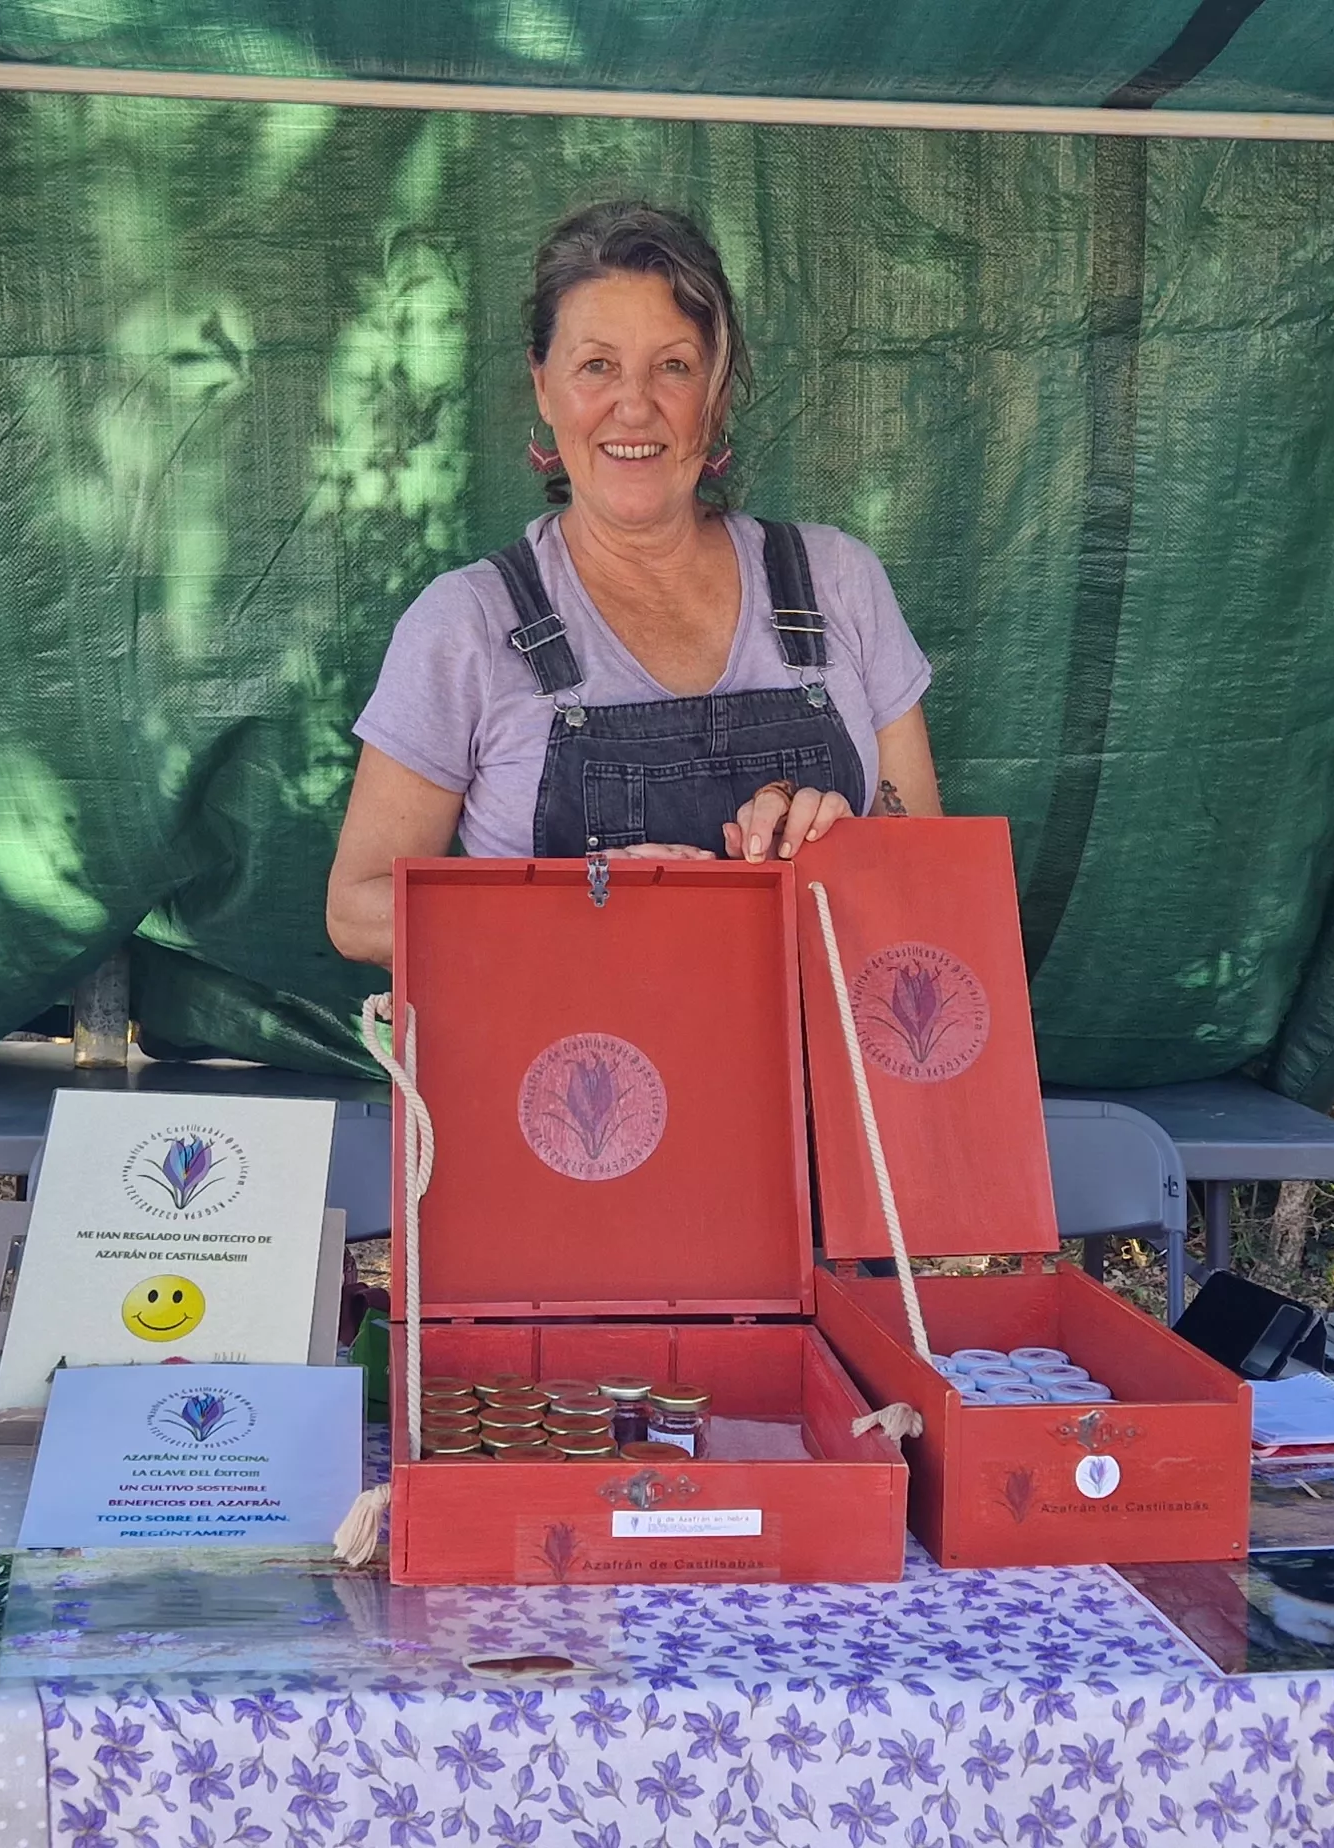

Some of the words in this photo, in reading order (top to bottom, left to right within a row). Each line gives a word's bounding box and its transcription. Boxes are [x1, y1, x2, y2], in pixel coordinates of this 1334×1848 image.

[76, 1230, 95, 1239] ME
[96, 1231, 122, 1240] HAN
[122, 1232, 181, 1242] REGALADO
[183, 1233, 201, 1242] UN
[202, 1234, 256, 1244] BOTECITO
[258, 1235, 273, 1244] DE
[95, 1249, 147, 1260] AZAFRÁN
[149, 1251, 164, 1260] DE
[122, 1452, 180, 1462] AZAFRÁN
[182, 1454, 200, 1462] EN
[201, 1454, 217, 1462] TU
[132, 1469, 148, 1477] LA
[149, 1469, 186, 1477] CLAVE
[189, 1469, 209, 1477] DEL
[119, 1484, 139, 1492] UN
[140, 1484, 194, 1492] CULTIVO
[196, 1484, 267, 1492] SOSTENIBLE
[108, 1499, 186, 1507] BENEFICIOS
[189, 1499, 214, 1507] DEL
[216, 1498, 281, 1507] AZAFRÁN
[1040, 1502, 1096, 1514] Azafrán
[1102, 1503, 1119, 1512] de
[144, 1514, 193, 1522] SOBRE
[120, 1528, 246, 1537] PREGÚNTAME???
[582, 1559, 643, 1570] Azafrán
[649, 1559, 667, 1570] de
